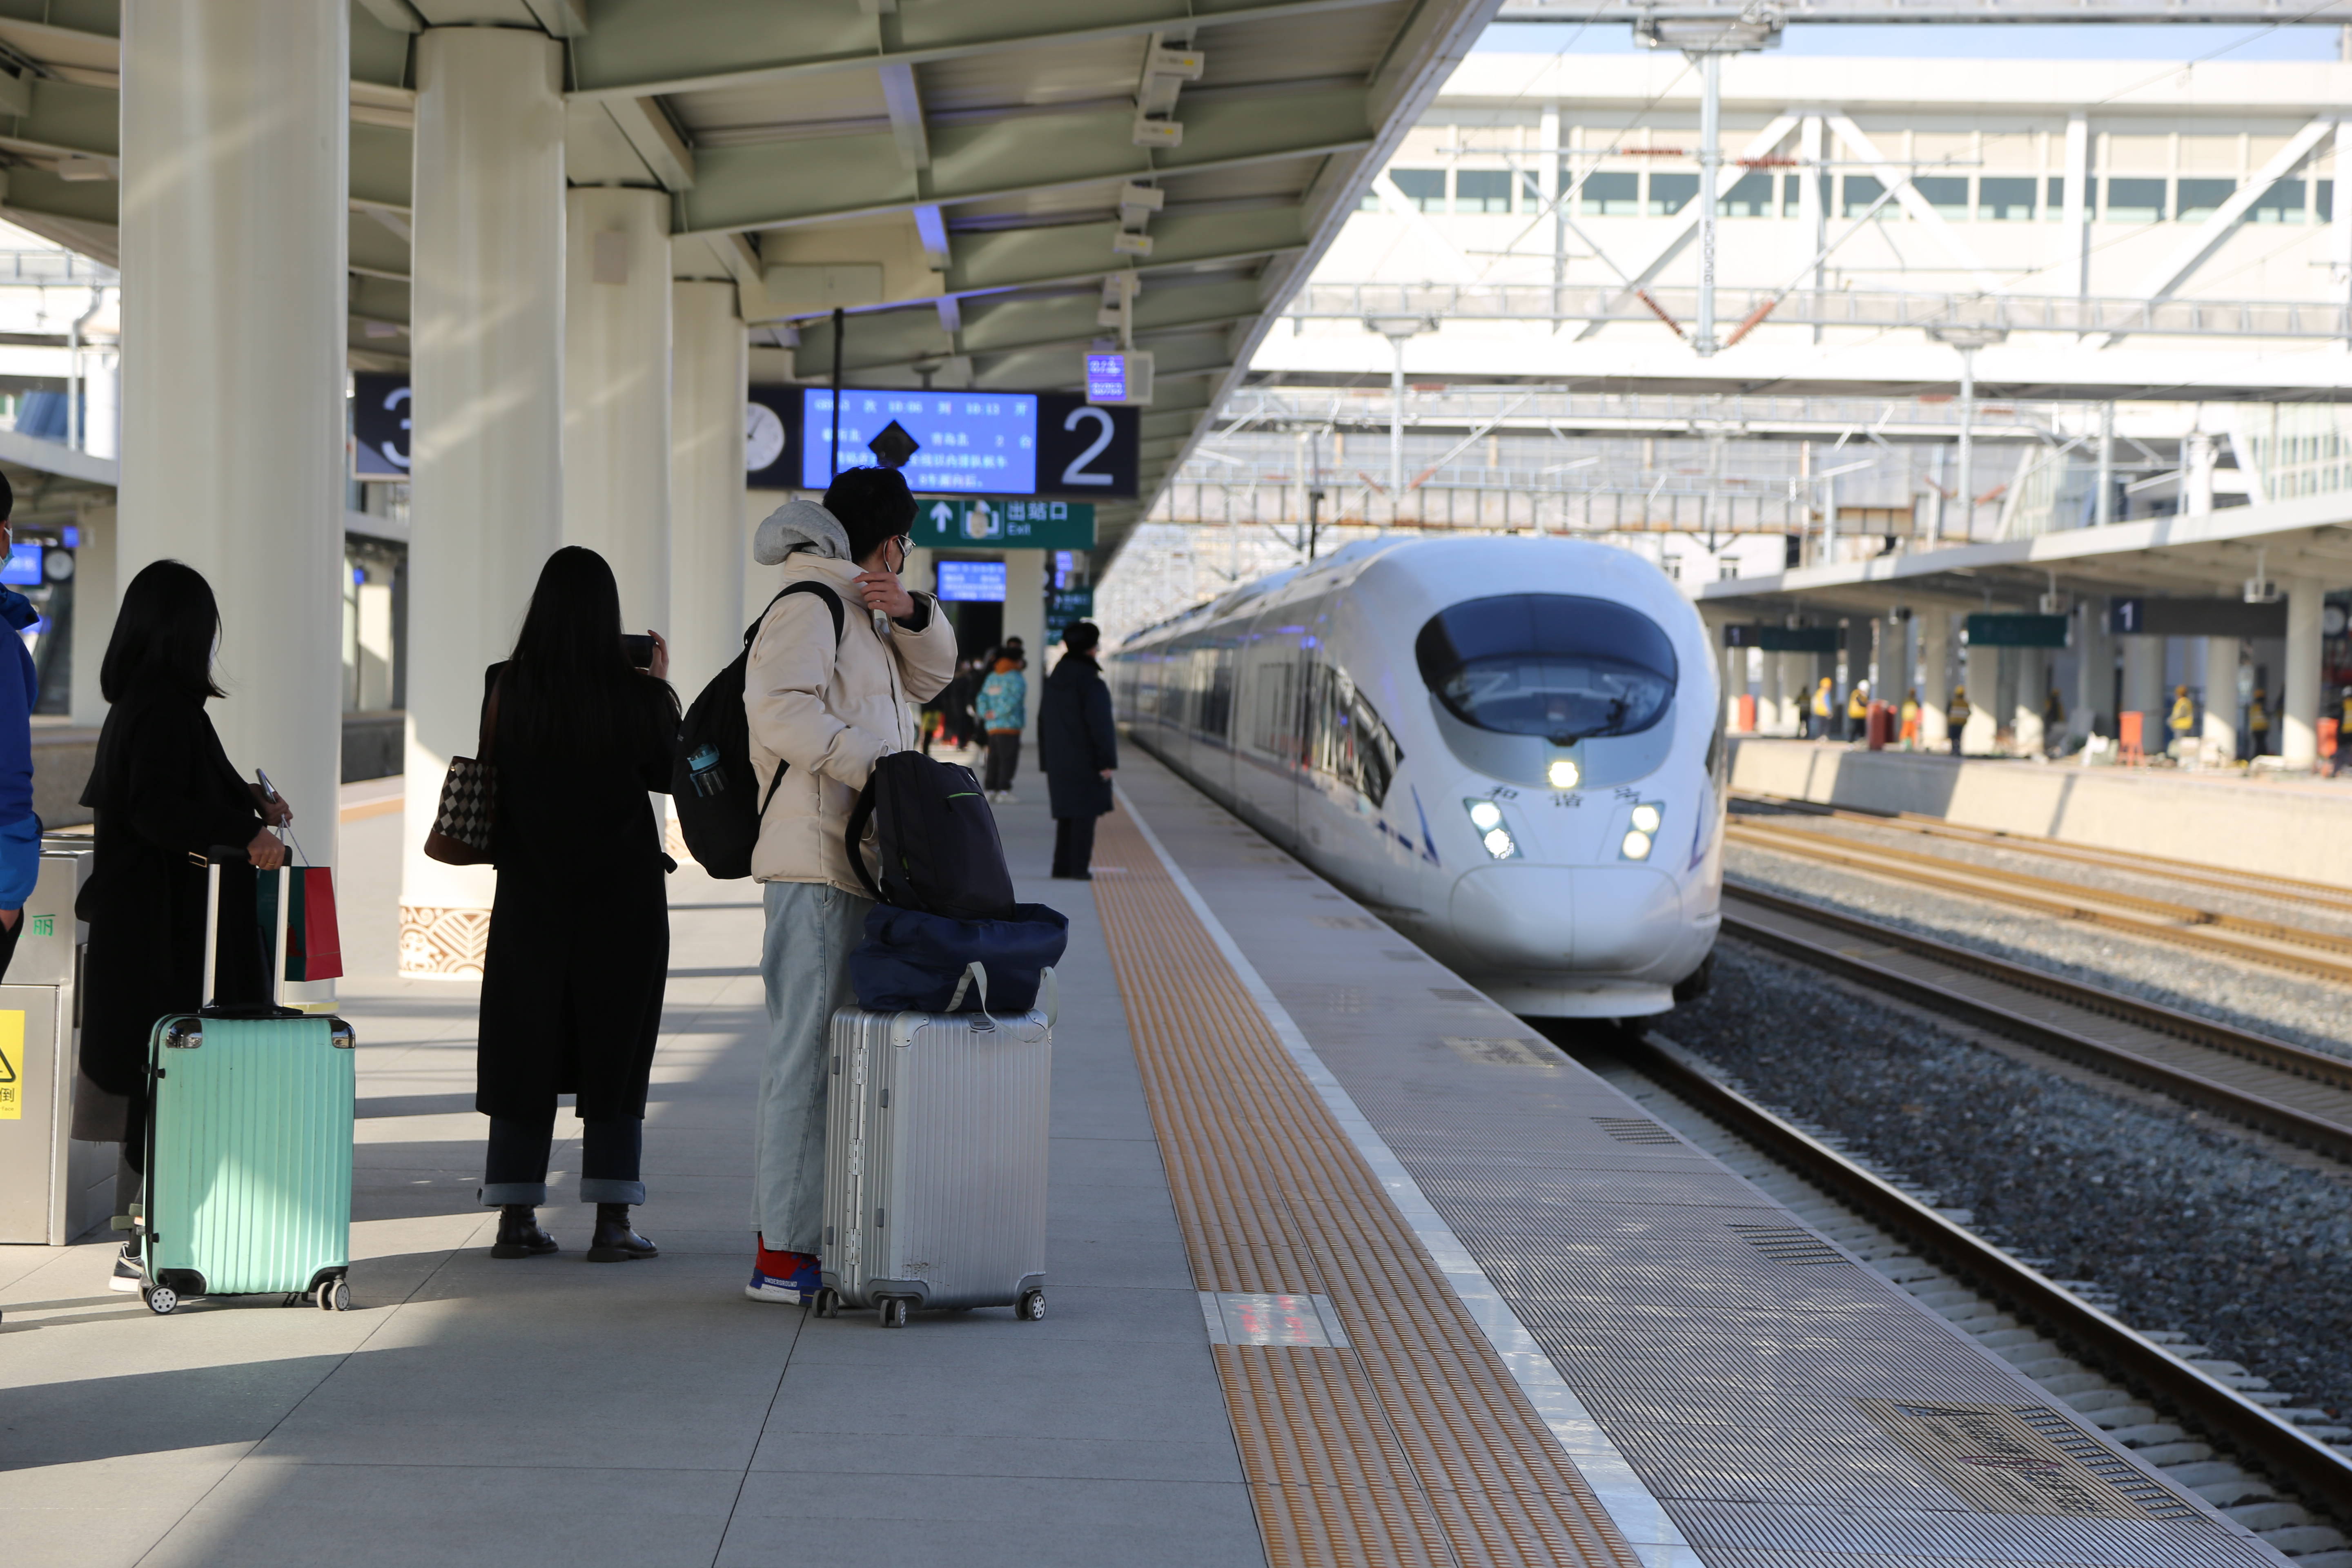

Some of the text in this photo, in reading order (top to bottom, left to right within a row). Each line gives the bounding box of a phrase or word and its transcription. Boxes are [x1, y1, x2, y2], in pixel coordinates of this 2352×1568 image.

[1062, 406, 1114, 485] 2
[1007, 501, 1068, 521] 出站口
[1007, 522, 1031, 536] Exit
[2120, 601, 2133, 631] 1
[1485, 786, 1641, 807] 和谐号
[764, 1276, 797, 1287] UNDERGROUND
